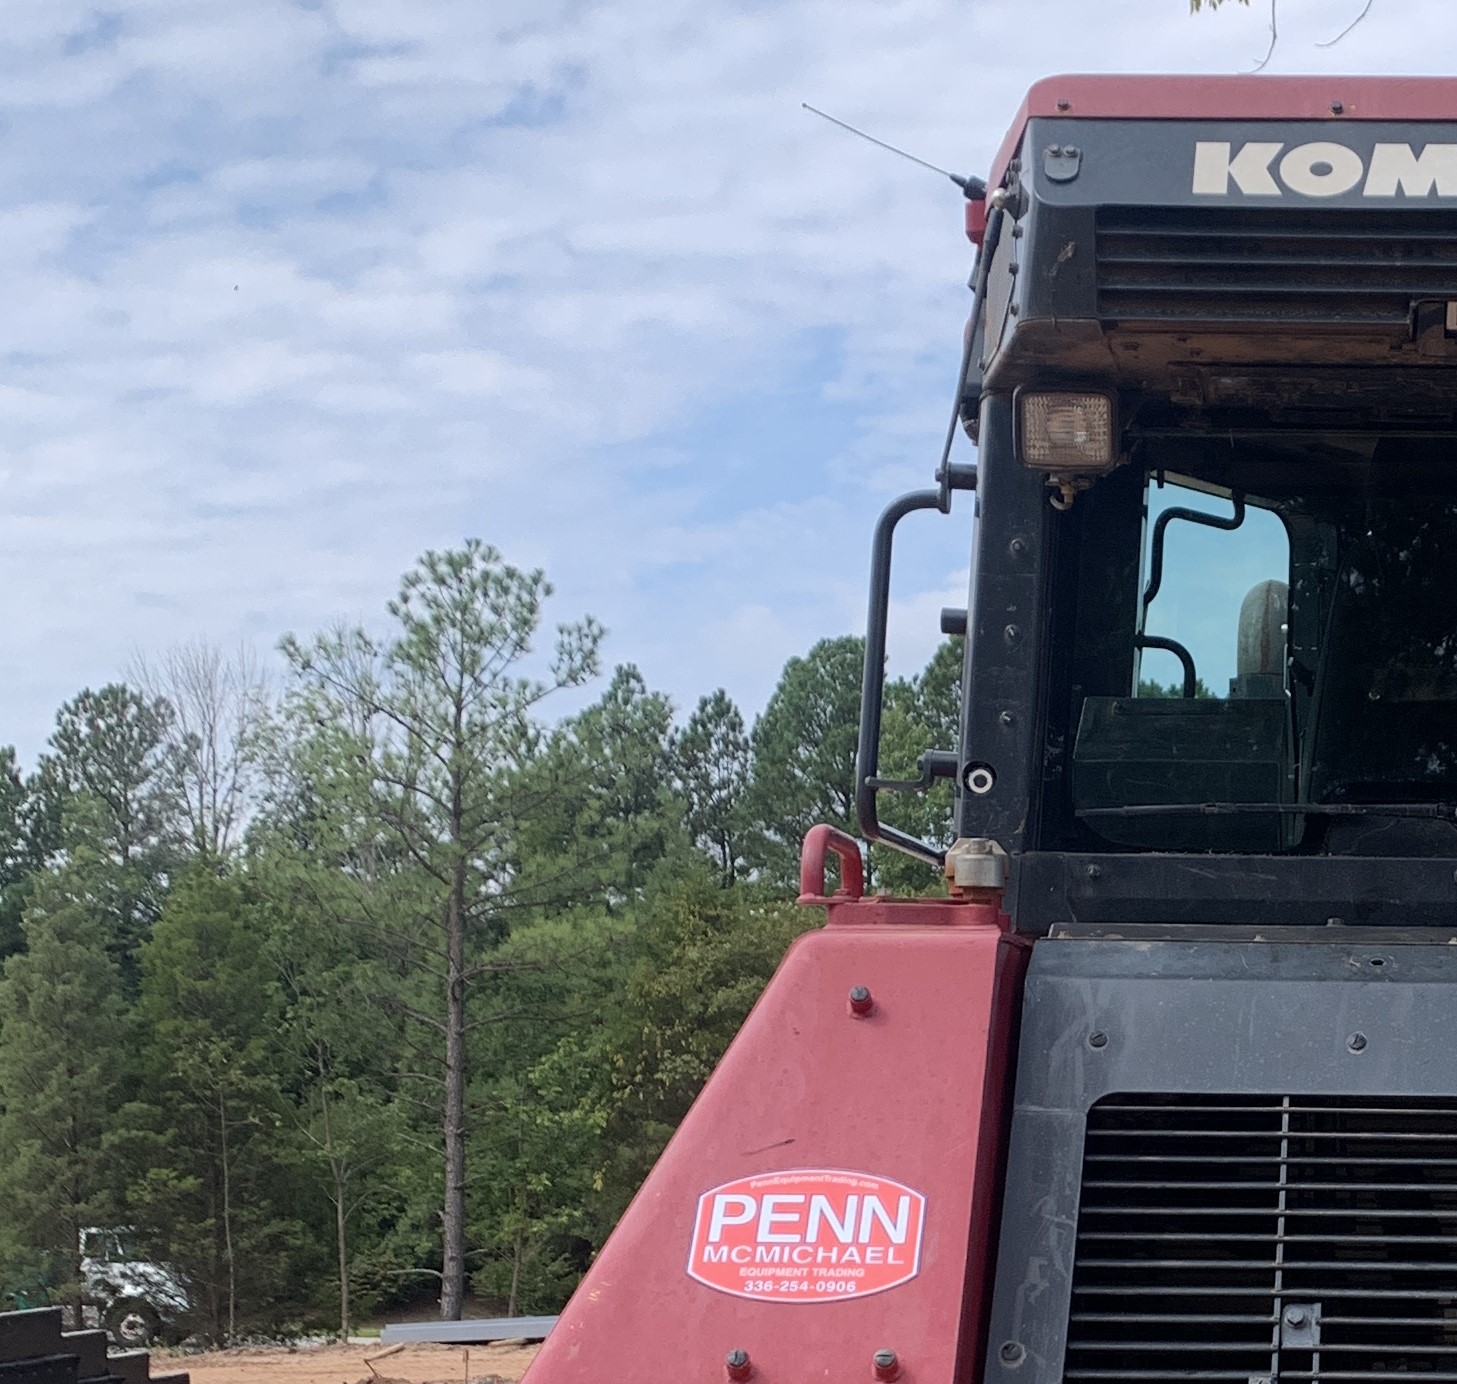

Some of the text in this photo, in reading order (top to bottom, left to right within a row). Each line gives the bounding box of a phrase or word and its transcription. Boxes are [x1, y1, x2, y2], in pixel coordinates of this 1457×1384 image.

[750, 1175, 879, 1190] PennEquipmentTrading.com
[707, 1194, 910, 1244] PENN
[702, 1245, 904, 1265] MCMICHAEL
[739, 1267, 865, 1278] EQUIPMENT TRADING
[744, 1280, 857, 1292] 336-254-0906
